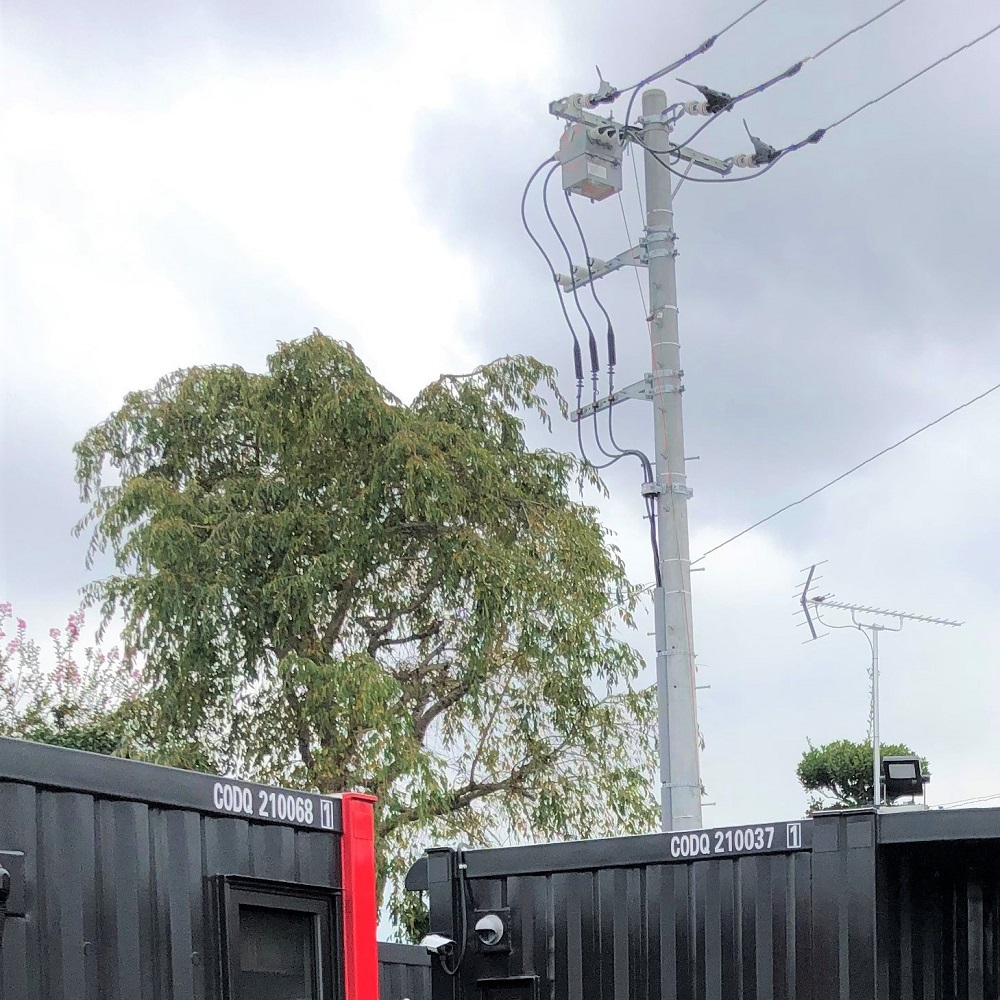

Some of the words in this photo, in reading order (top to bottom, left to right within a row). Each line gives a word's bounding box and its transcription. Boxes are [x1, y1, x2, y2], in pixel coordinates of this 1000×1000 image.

[213, 782, 253, 815] CODQ
[259, 790, 314, 825] 210068
[321, 801, 332, 828] 1
[670, 833, 711, 858] CODQ
[714, 826, 775, 853] 210037
[788, 824, 799, 848] 1
